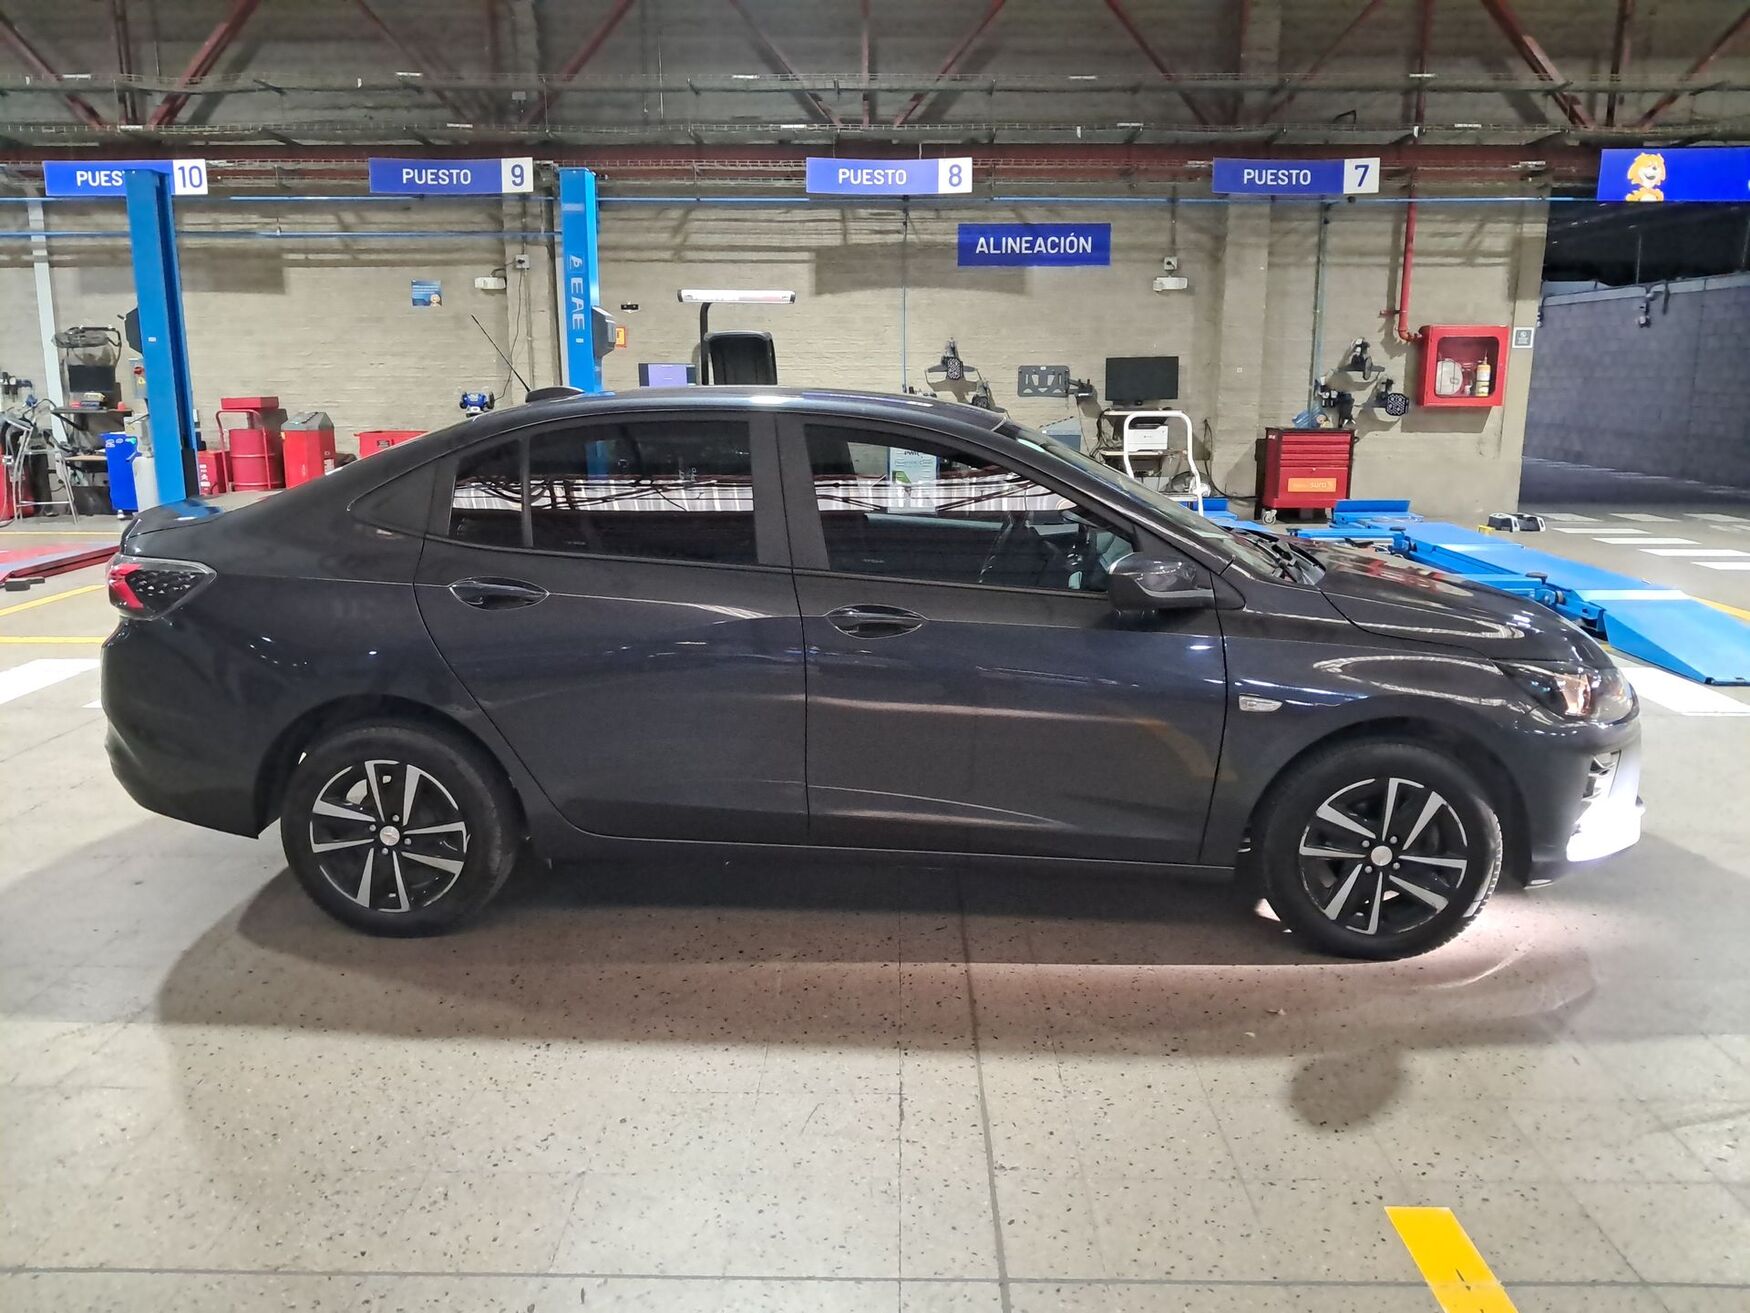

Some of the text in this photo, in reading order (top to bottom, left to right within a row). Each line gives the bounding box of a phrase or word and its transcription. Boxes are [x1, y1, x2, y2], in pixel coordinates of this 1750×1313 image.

[76, 165, 203, 188] PUES 10
[402, 164, 525, 187] PUESTO 9
[838, 164, 962, 187] PUESTO 8
[1243, 164, 1370, 187] PUESTO 7
[975, 233, 1092, 254] ALINEACIÓN
[570, 277, 585, 330] EAE
